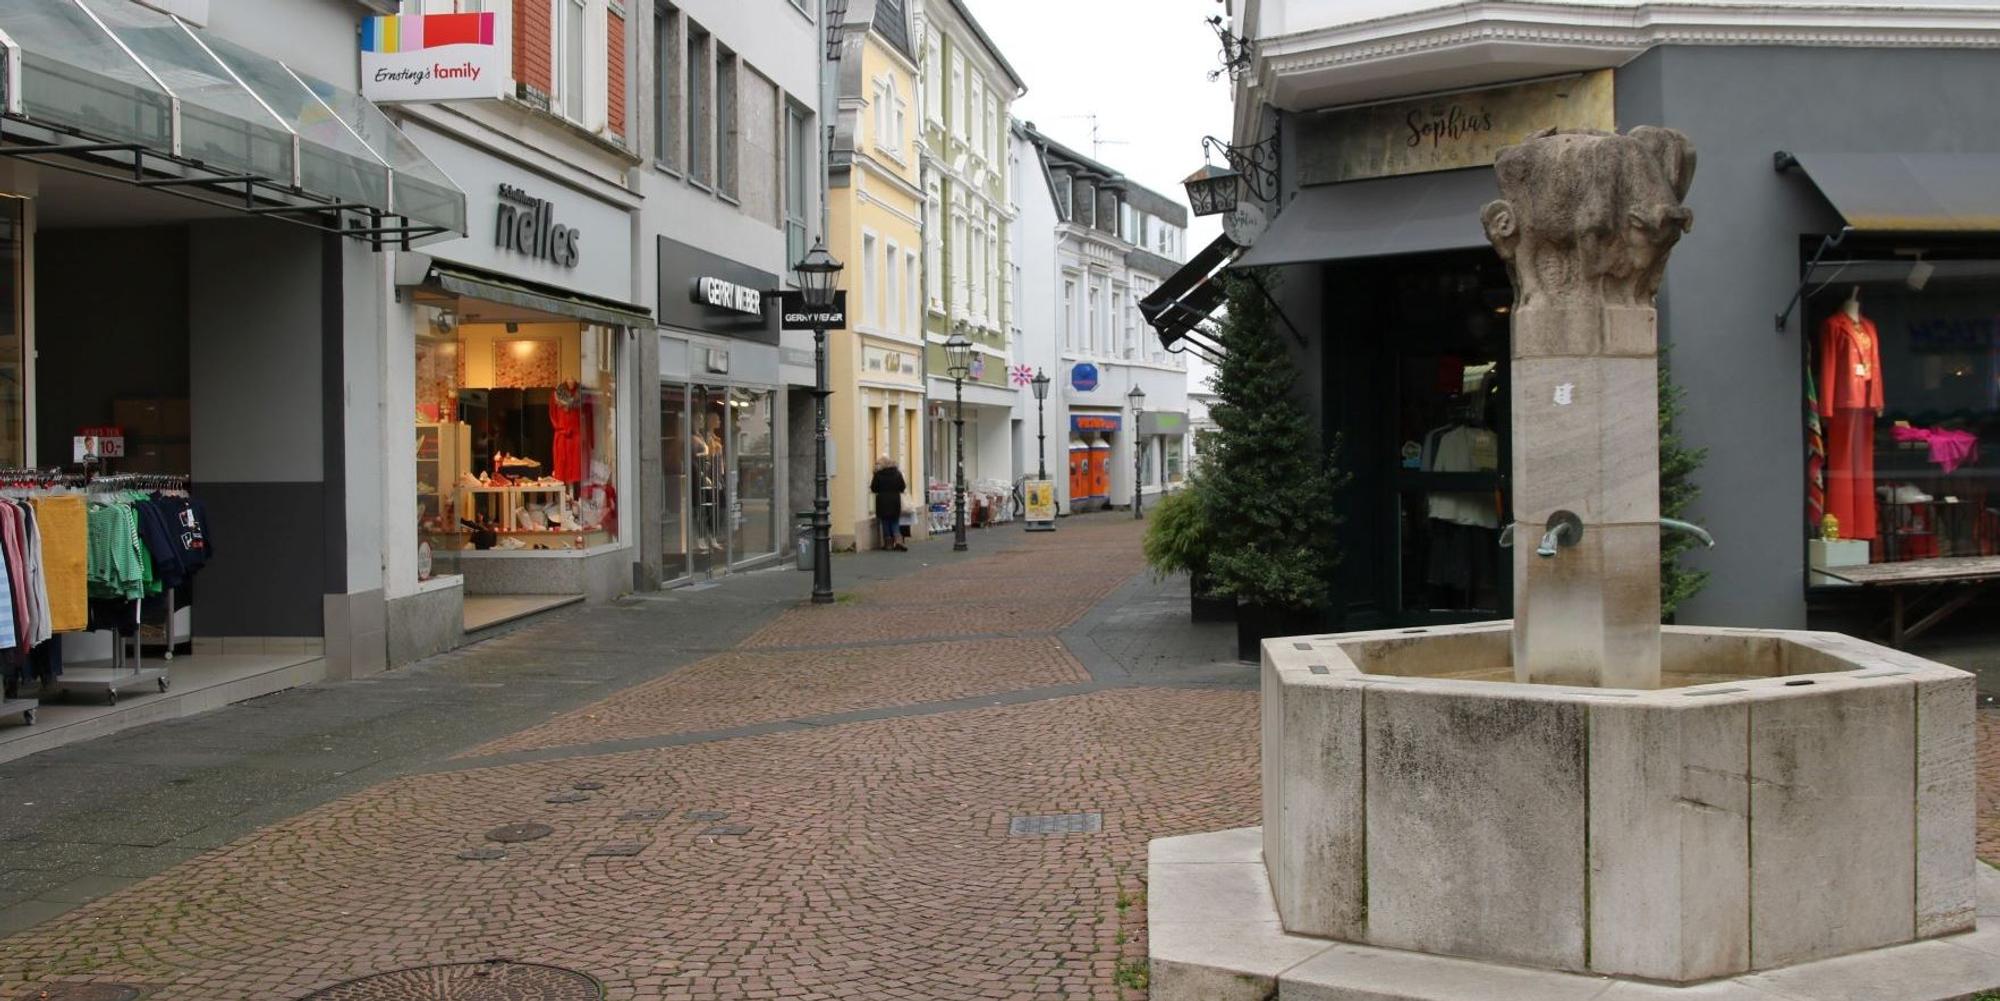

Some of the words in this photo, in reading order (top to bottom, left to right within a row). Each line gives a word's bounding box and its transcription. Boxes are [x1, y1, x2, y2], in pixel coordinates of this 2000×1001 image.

[374, 66, 431, 85] Ernsting's
[434, 62, 481, 81] family
[1407, 103, 1491, 149] Sophia's
[495, 199, 581, 269] nelles
[707, 277, 734, 309] GERRY
[734, 284, 761, 316] WEBER
